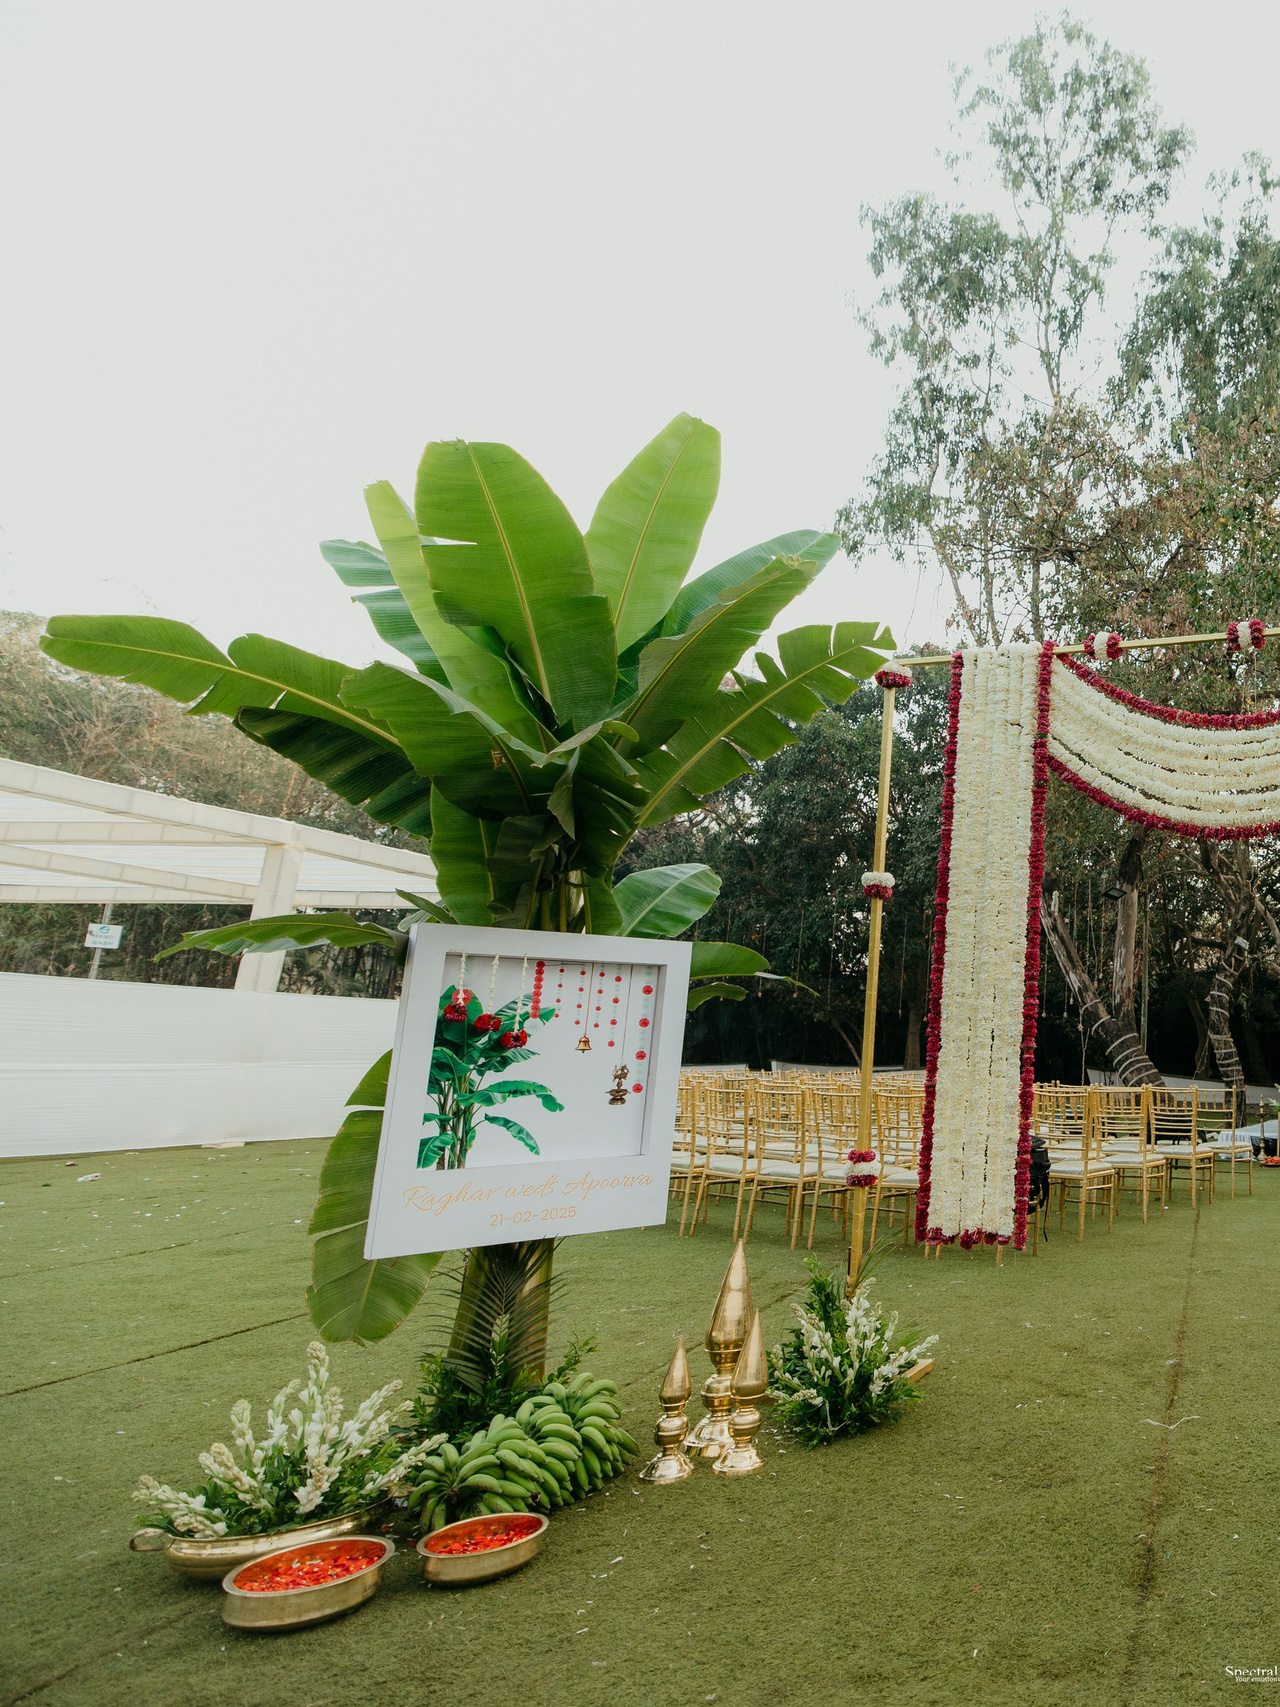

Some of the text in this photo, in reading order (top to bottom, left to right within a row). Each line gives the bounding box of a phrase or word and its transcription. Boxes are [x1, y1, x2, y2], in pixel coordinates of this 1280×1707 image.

[402, 1171, 654, 1216] Raghav weds Apoorva
[489, 1206, 577, 1227] 21-02-2025
